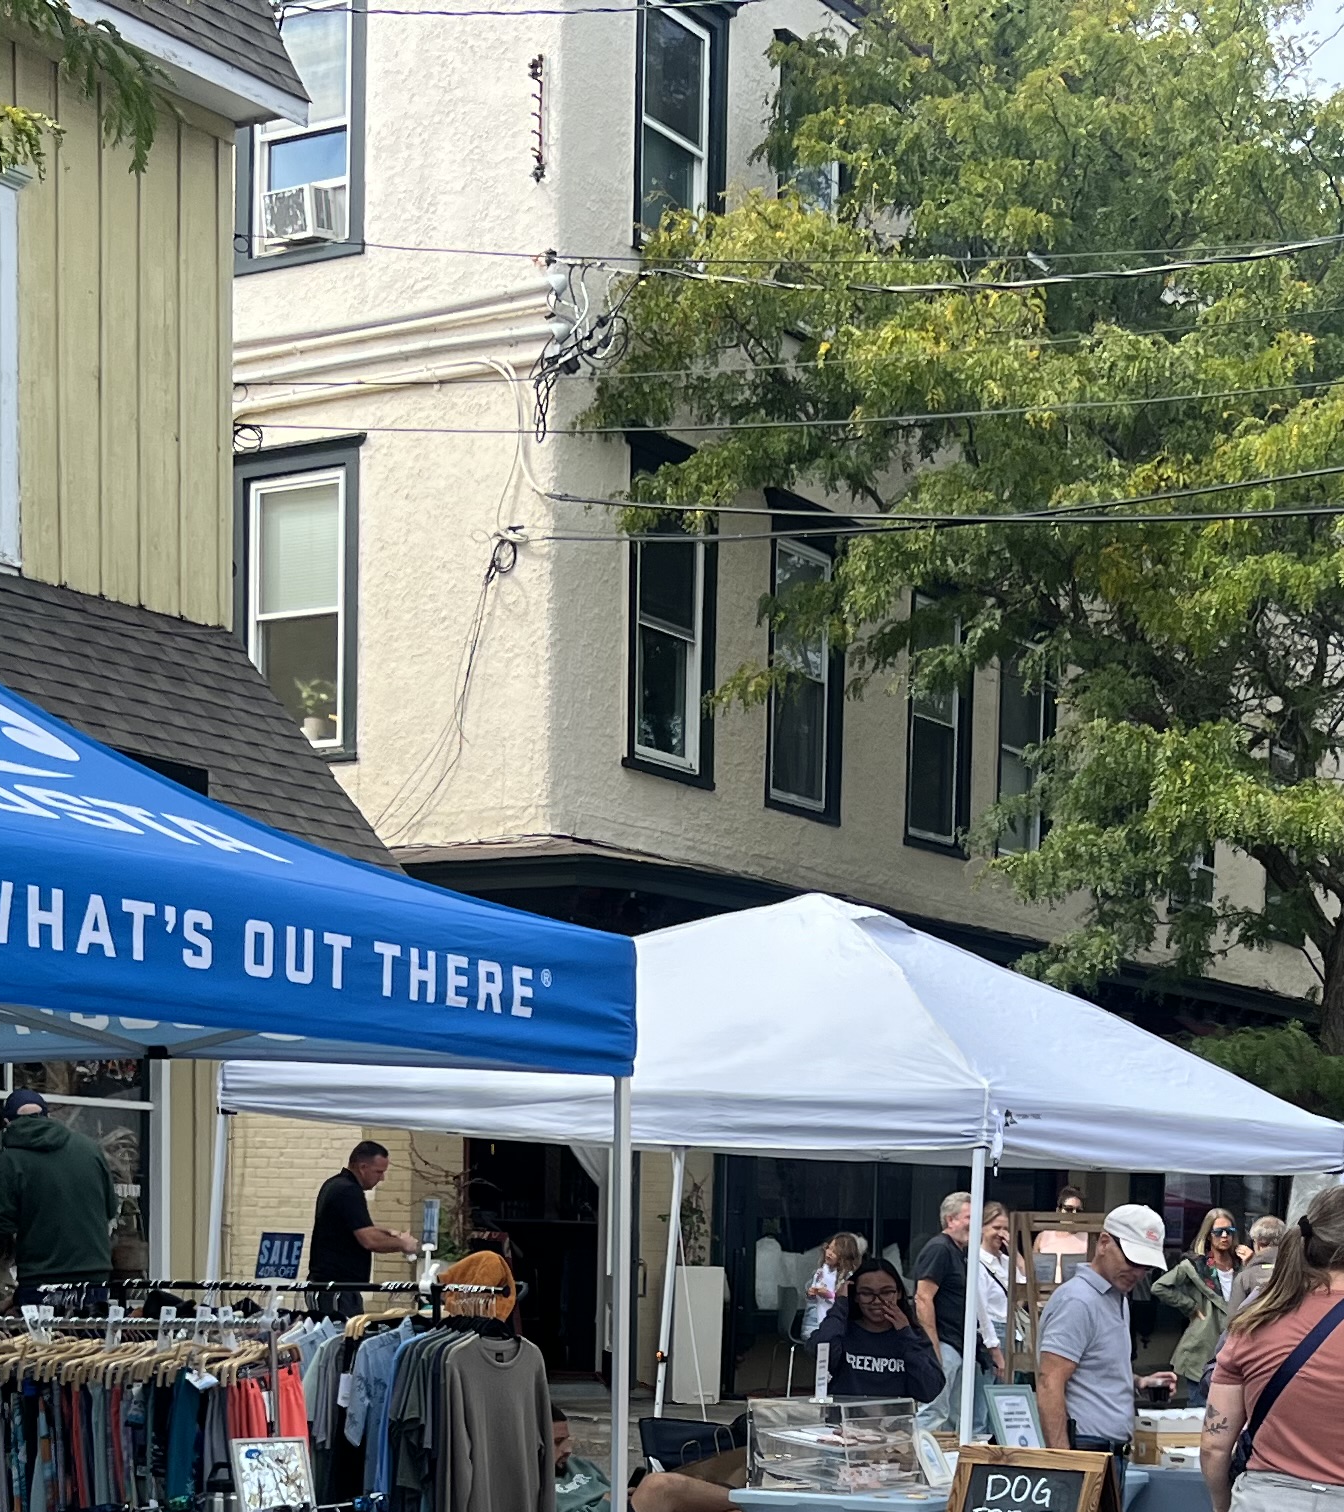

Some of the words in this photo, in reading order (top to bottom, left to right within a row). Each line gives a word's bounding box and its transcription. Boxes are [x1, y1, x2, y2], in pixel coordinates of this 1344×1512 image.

[244, 918, 353, 990] OUT
[259, 1239, 302, 1266] SALE
[278, 1265, 296, 1278] OFF
[845, 1351, 906, 1373] REENPOR
[985, 1474, 1052, 1508] DOG
